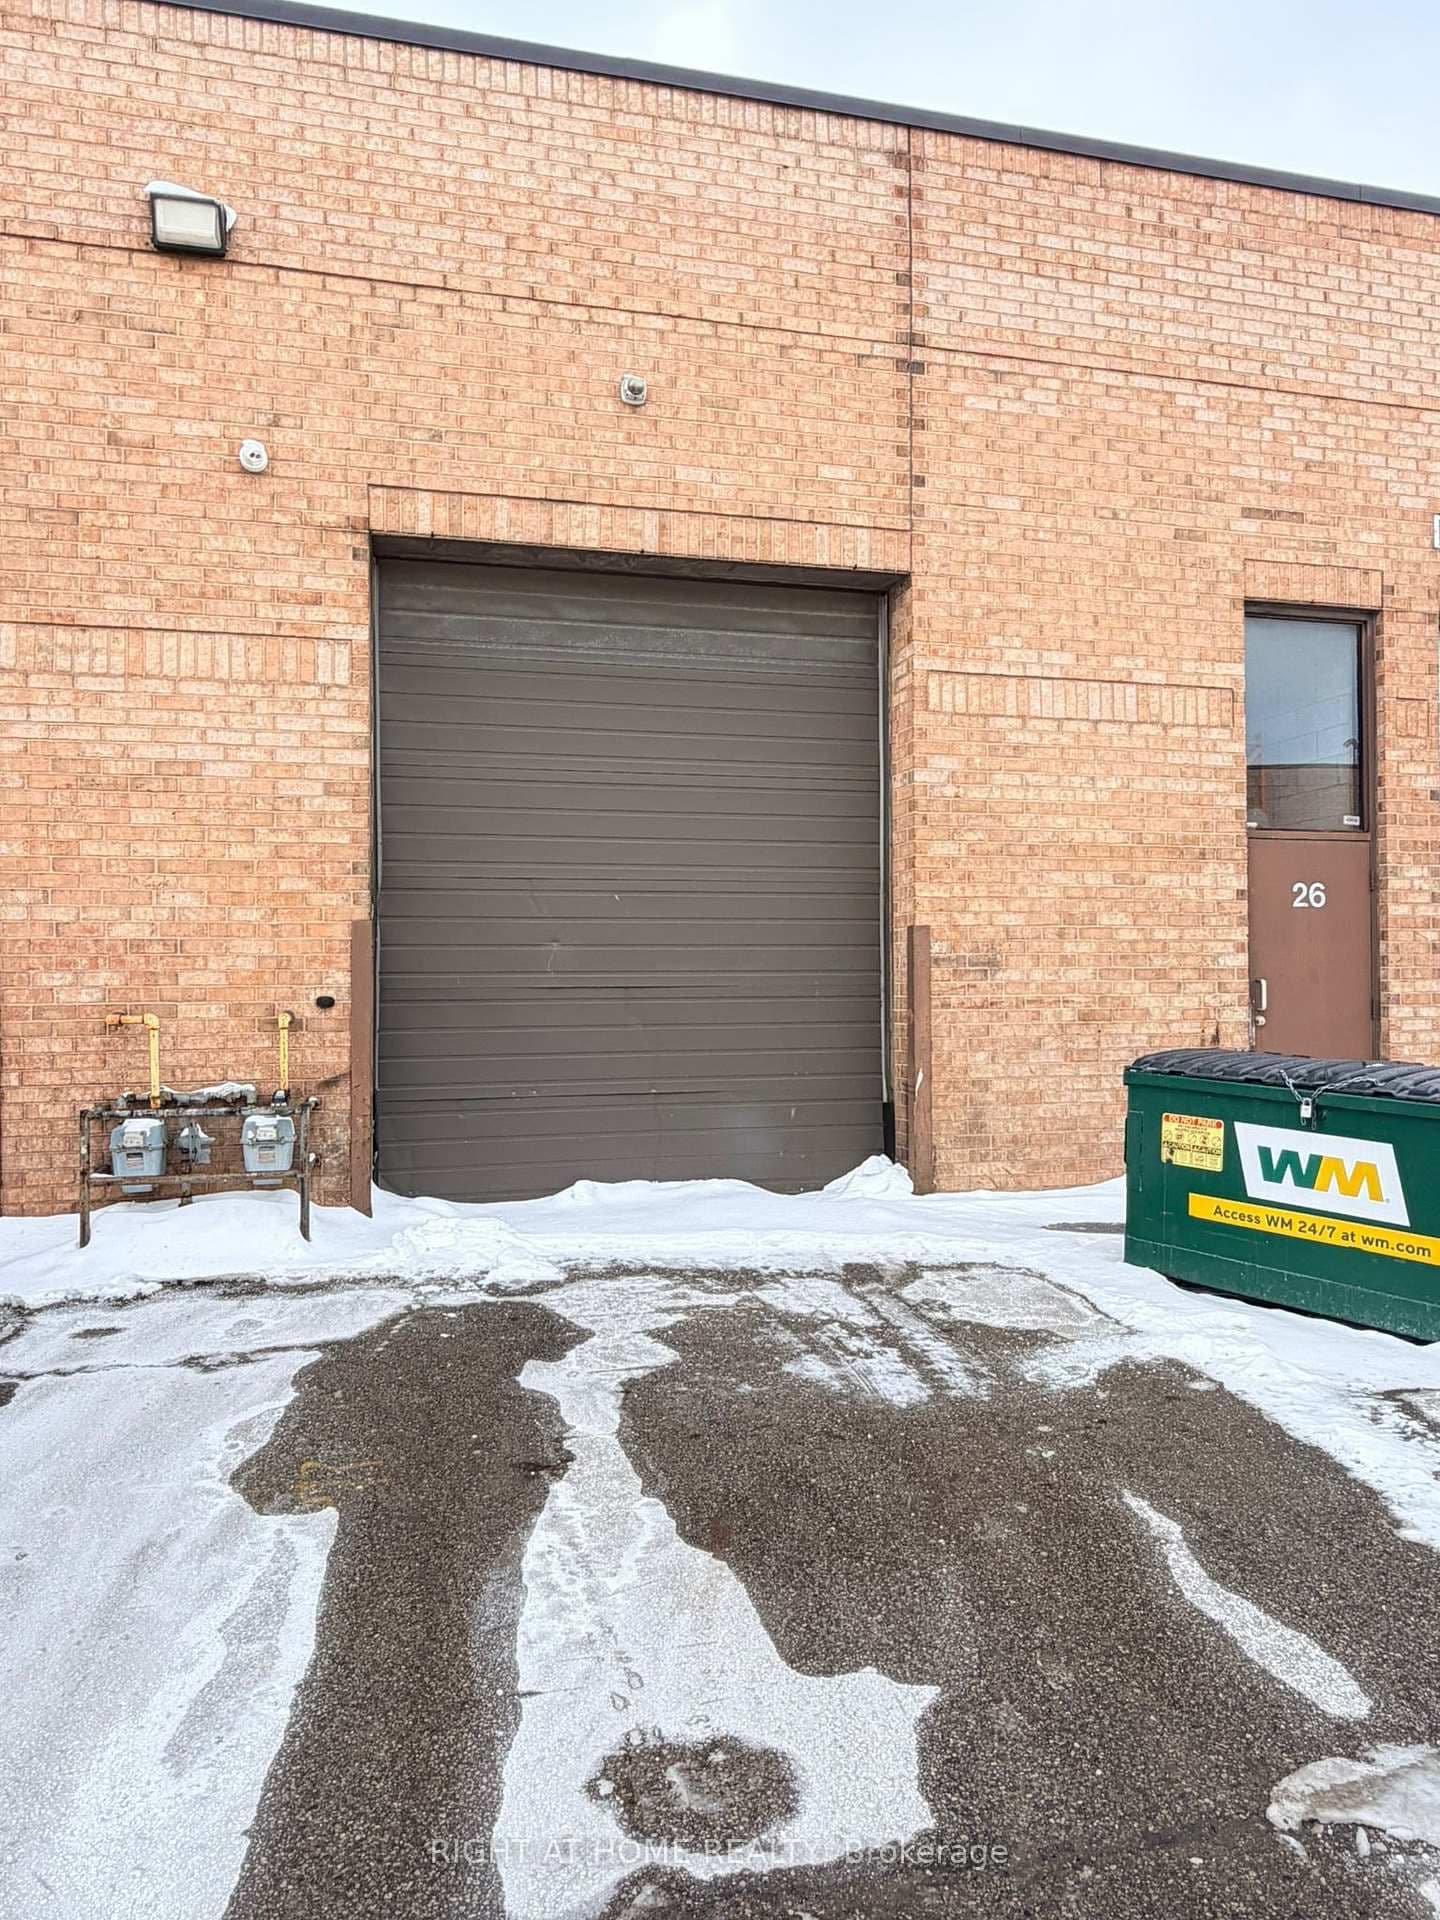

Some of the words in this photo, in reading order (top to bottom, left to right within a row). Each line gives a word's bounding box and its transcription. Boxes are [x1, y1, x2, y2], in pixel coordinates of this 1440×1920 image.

[1292, 882, 1326, 908] 26
[1257, 1145, 1384, 1202] WM
[1213, 1205, 1261, 1225] Access
[1265, 1214, 1293, 1231] WM
[1298, 1220, 1336, 1239] 24/7
[1341, 1230, 1356, 1243] at
[1361, 1236, 1431, 1258] wm.com
